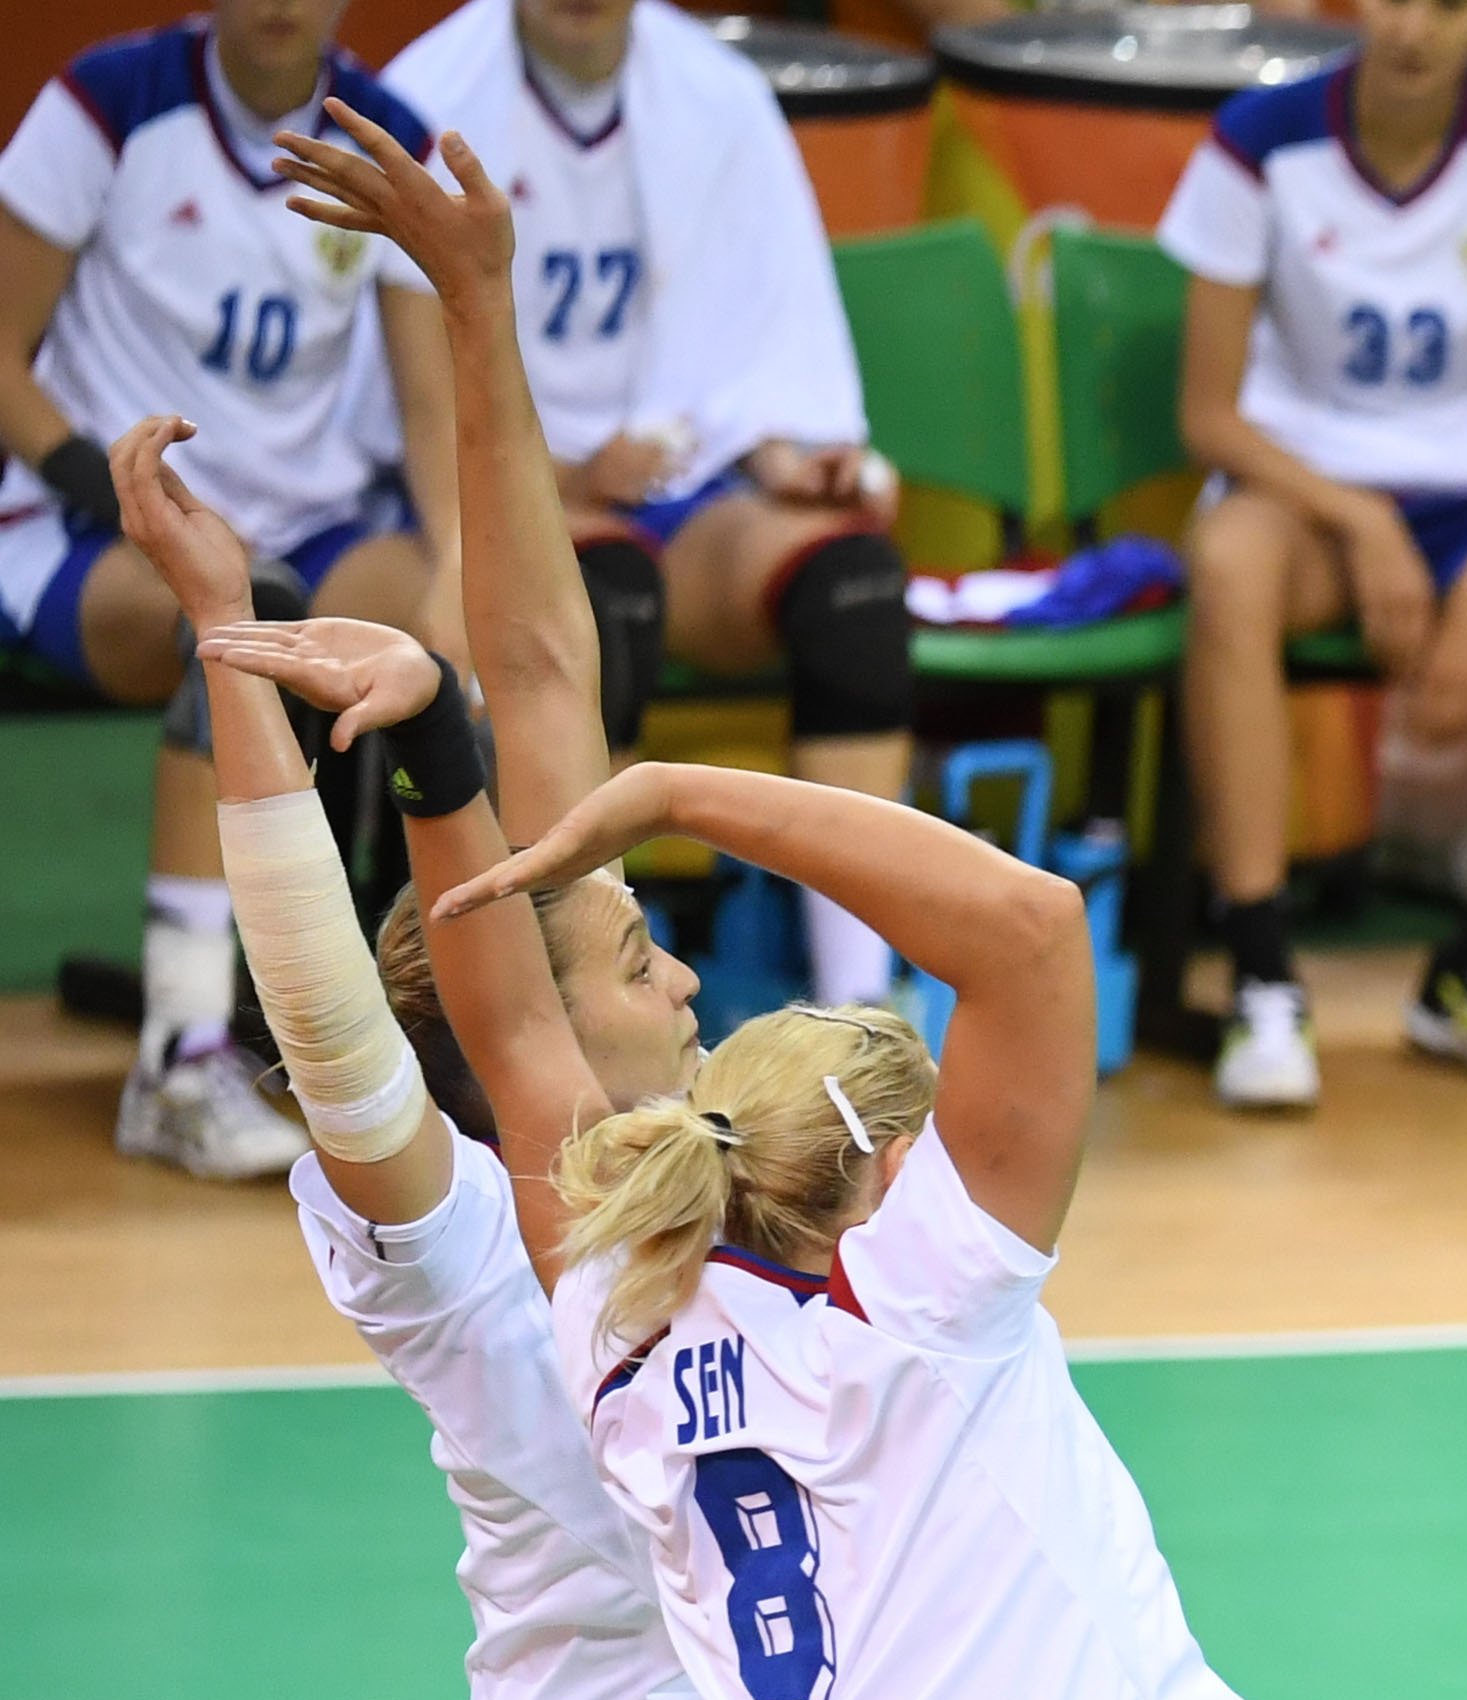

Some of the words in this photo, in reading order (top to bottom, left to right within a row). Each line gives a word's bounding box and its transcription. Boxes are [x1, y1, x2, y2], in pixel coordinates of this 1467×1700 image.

[202, 289, 299, 382] 10
[541, 248, 642, 340] 77
[1344, 304, 1446, 385] 33
[673, 1333, 747, 1446] SEN
